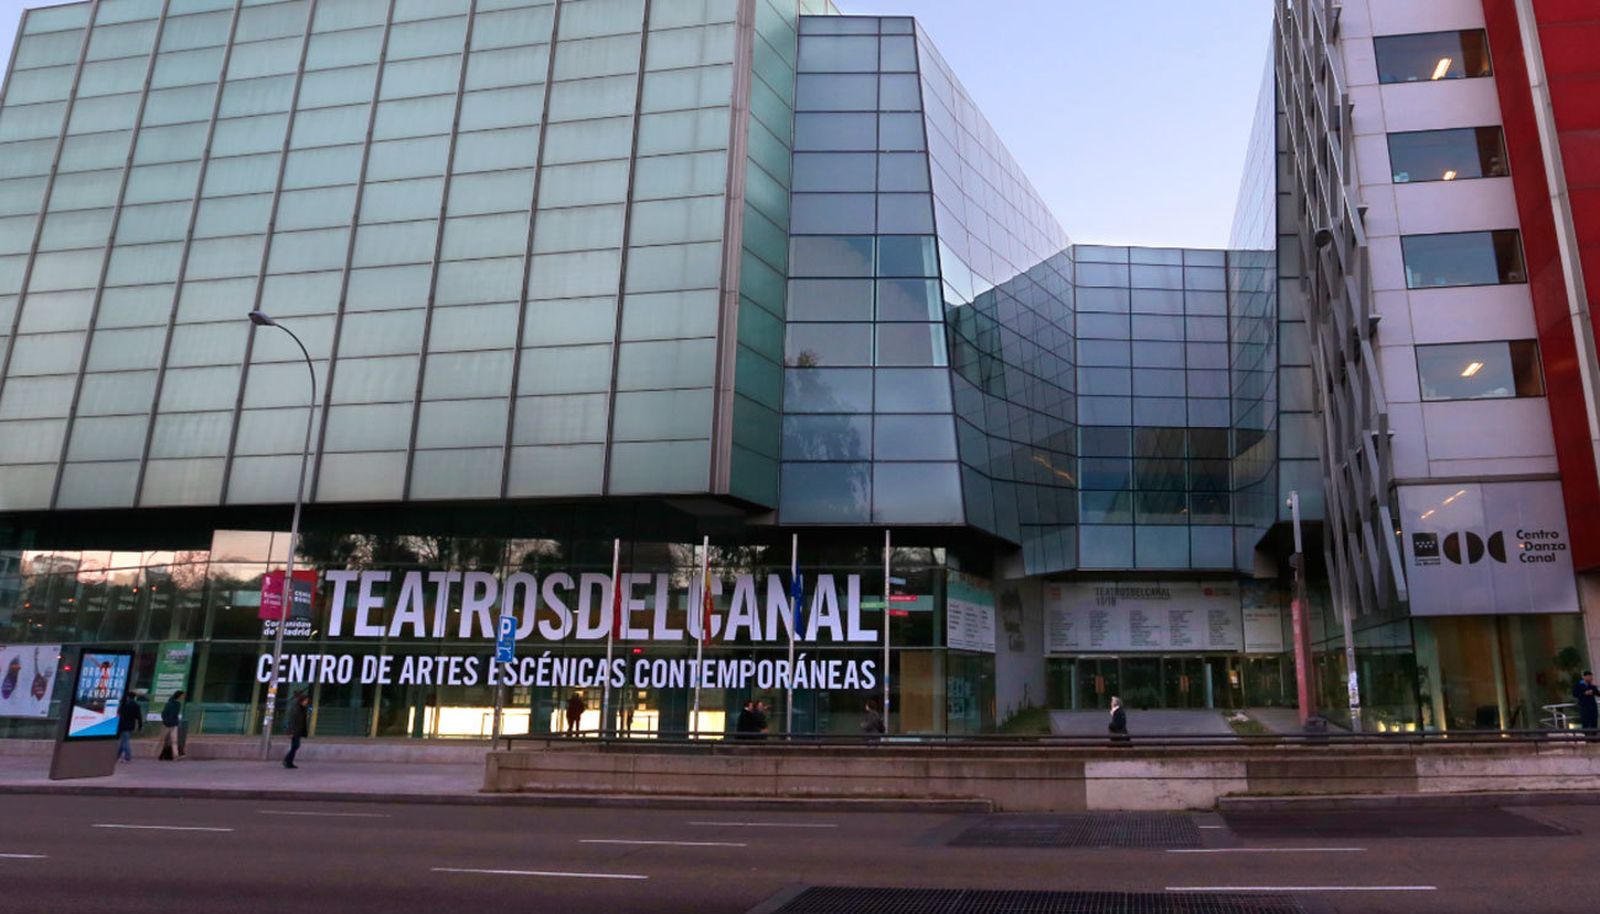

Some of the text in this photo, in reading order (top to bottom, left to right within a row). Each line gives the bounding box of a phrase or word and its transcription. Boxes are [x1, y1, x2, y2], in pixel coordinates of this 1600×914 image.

[1516, 529, 1560, 540] Centro
[1523, 541, 1567, 551] Danza
[1519, 553, 1557, 564] Canal
[325, 570, 878, 642] TEATROSDELCANAL
[282, 627, 311, 636] adrid
[500, 618, 512, 642] P
[257, 650, 877, 690] CENTRO DE ARTES ESCÉNICAS CONTEMPORÁNEAS
